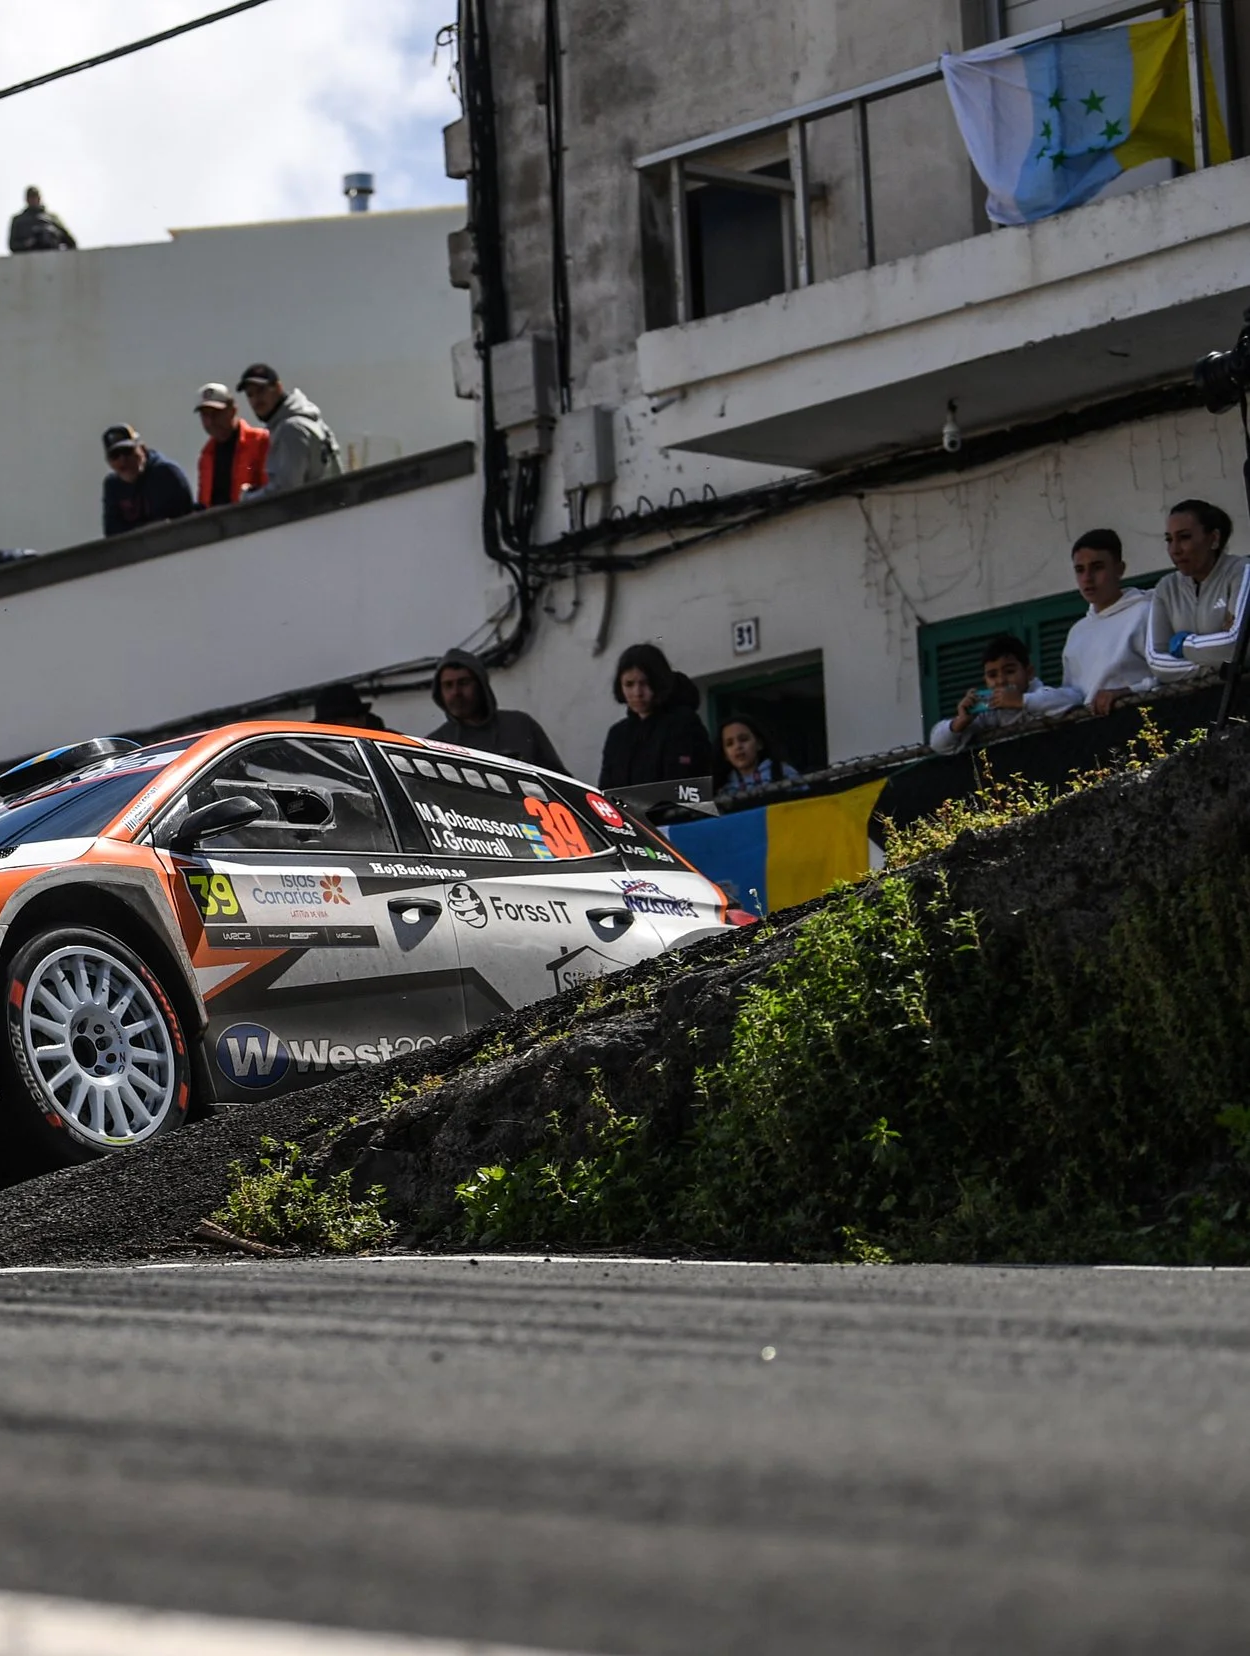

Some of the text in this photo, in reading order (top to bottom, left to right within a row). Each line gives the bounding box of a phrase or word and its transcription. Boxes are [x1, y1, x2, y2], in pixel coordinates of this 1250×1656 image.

[737, 626, 753, 647] 31
[524, 796, 593, 858] 39
[279, 872, 316, 888] Islas
[189, 874, 239, 916] 39
[252, 888, 322, 905] Canarias
[489, 896, 572, 924] Forss IT
